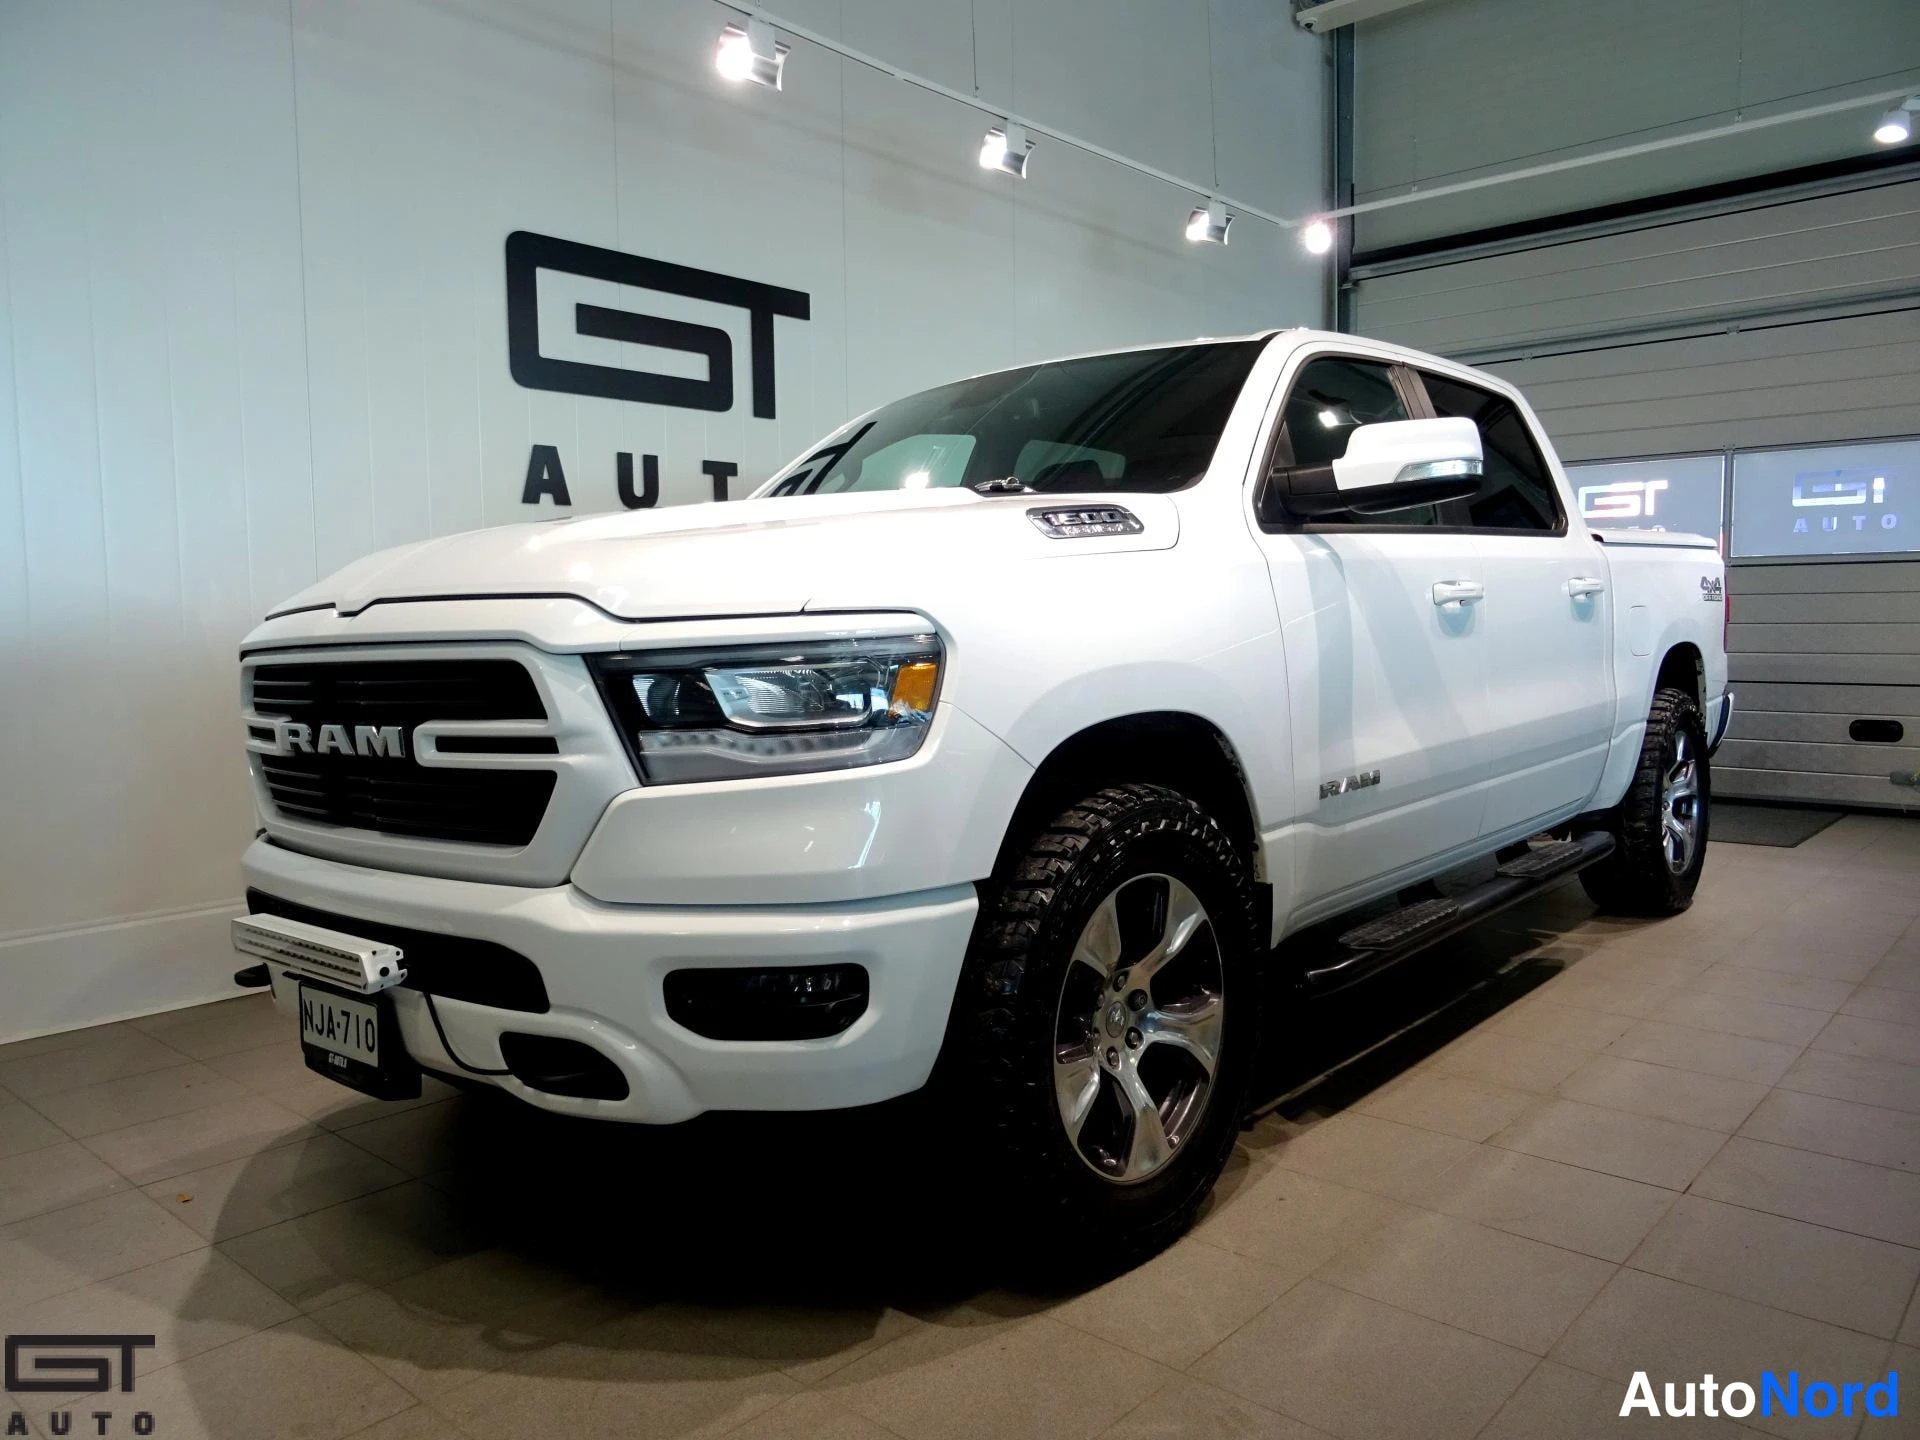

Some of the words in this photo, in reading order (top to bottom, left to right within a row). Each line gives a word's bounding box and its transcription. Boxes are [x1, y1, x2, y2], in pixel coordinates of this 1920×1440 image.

[505, 230, 810, 420] GT
[521, 443, 738, 509] AUT
[1578, 480, 1669, 519] GT
[1793, 513, 1898, 534] AUTO
[280, 721, 406, 759] RAM
[1319, 769, 1381, 801] RAM
[303, 998, 376, 1054] NJA-710
